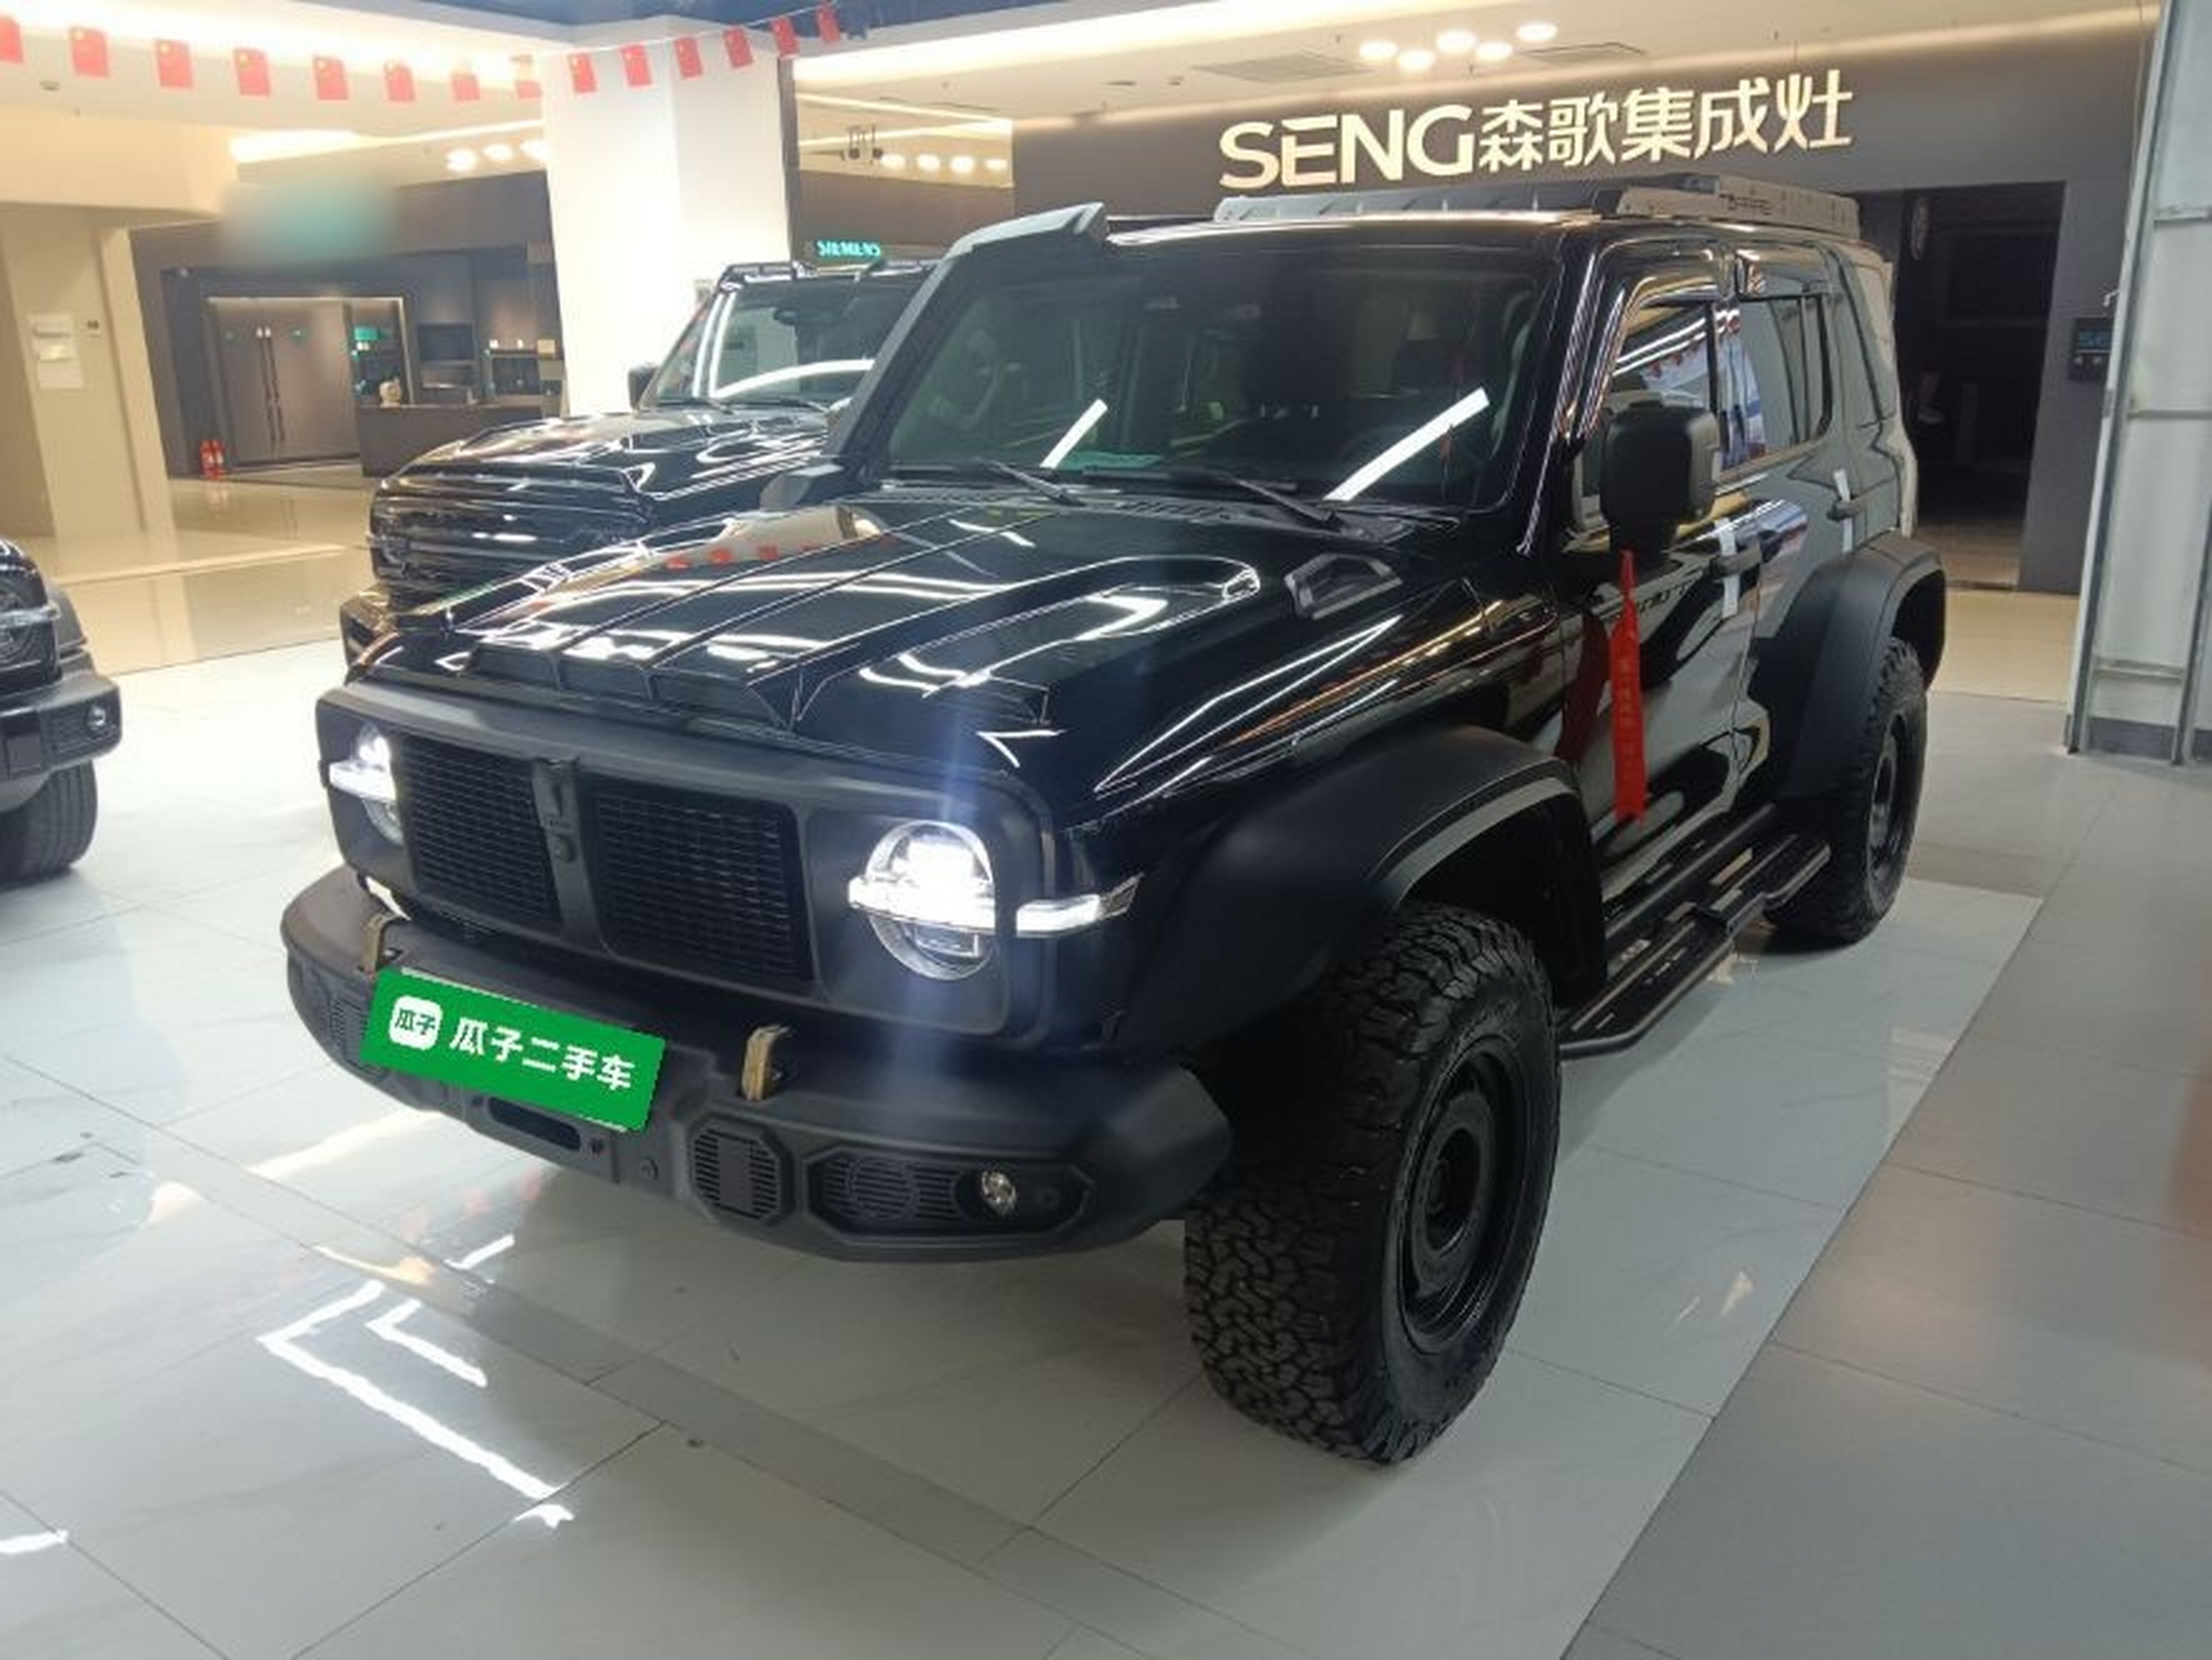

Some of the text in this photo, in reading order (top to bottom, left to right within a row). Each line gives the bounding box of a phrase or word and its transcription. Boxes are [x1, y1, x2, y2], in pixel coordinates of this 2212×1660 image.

[1219, 105, 1475, 189] SENG
[1478, 69, 1853, 173] 森歌集成灶
